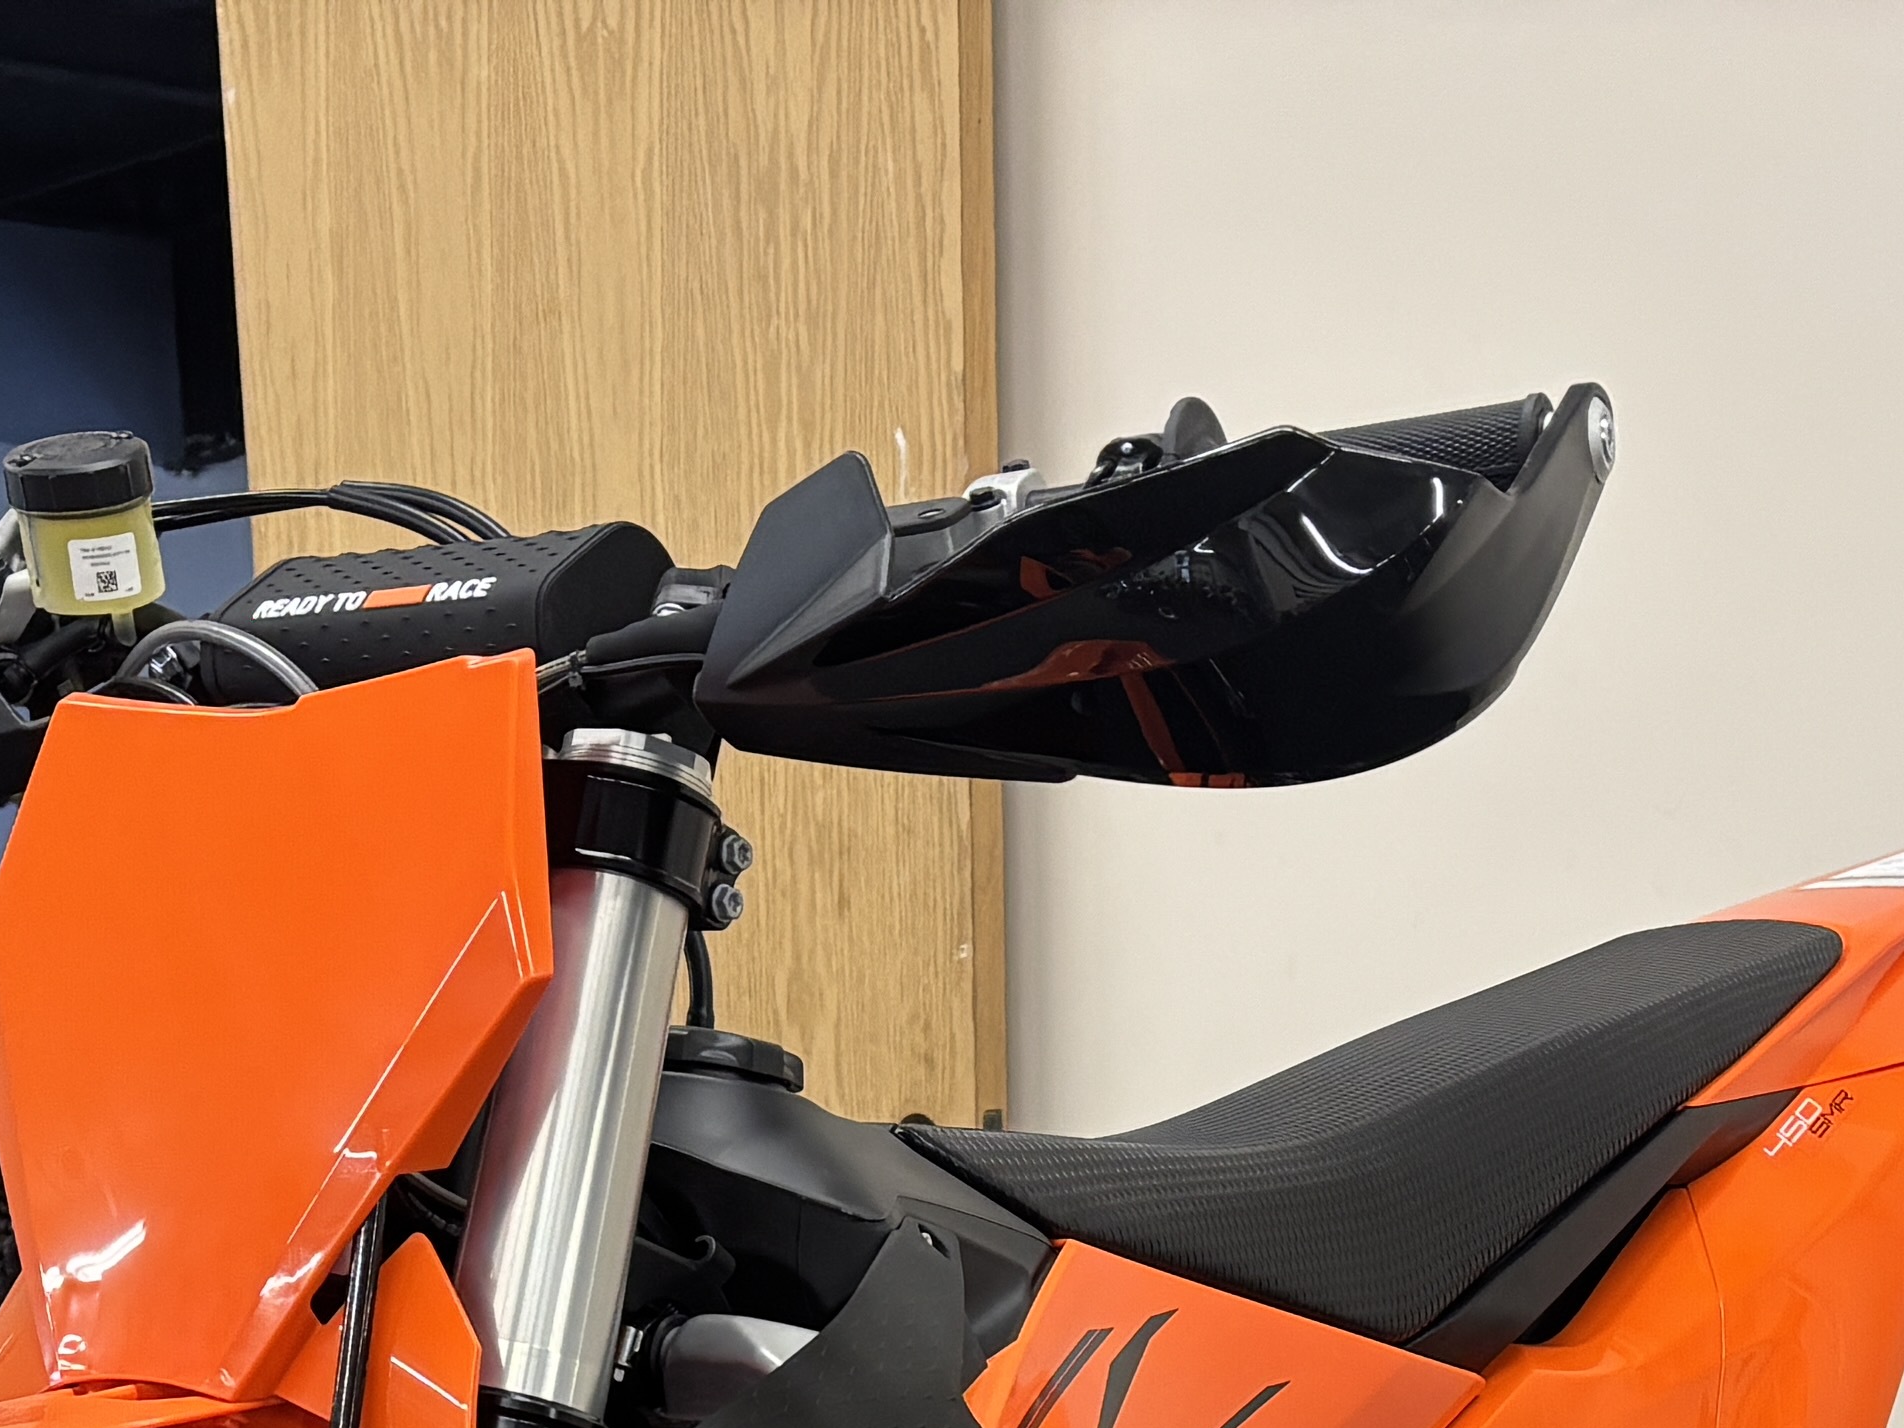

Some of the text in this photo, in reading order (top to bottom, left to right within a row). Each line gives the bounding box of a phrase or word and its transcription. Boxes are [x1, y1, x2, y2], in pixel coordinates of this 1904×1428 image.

[252, 576, 497, 620] READY TO RACE
[1763, 1097, 1823, 1157] 450
[1809, 1089, 1854, 1139] SMR
